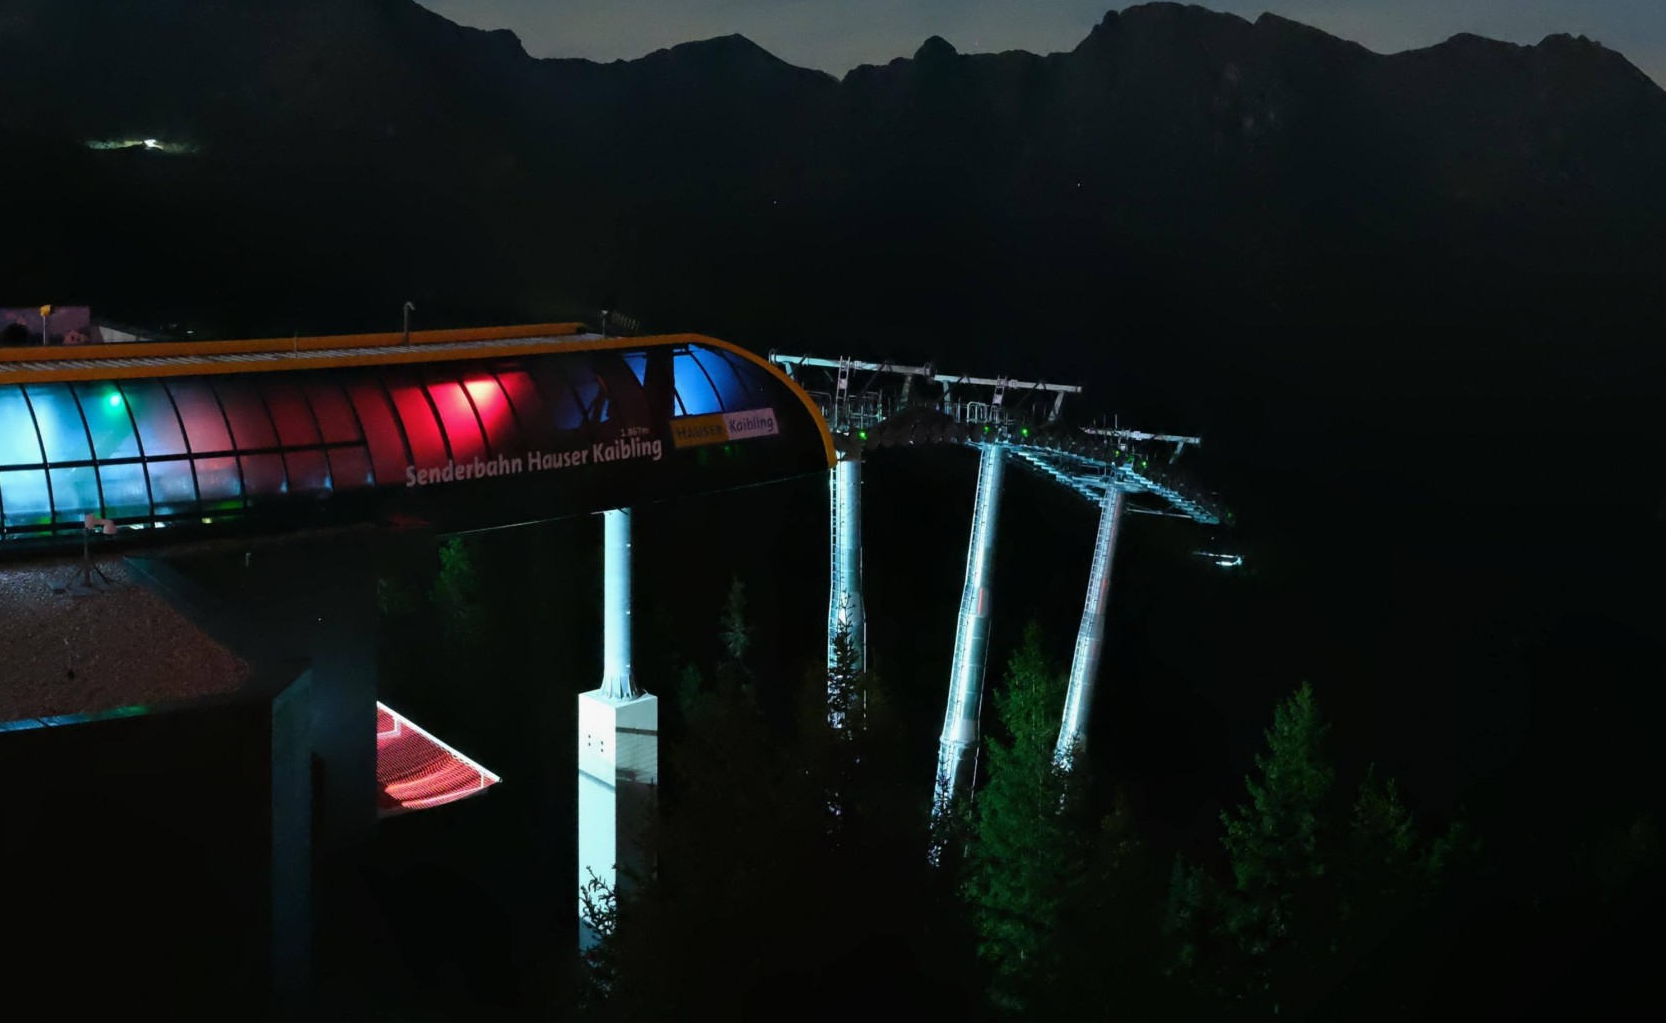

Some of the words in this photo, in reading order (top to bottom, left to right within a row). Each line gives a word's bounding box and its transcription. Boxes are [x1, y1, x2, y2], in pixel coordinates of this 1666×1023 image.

[729, 417, 775, 432] Kaibling
[405, 454, 523, 488] Senderbahn
[527, 449, 588, 472] Hauser
[593, 437, 663, 464] Kaibling
